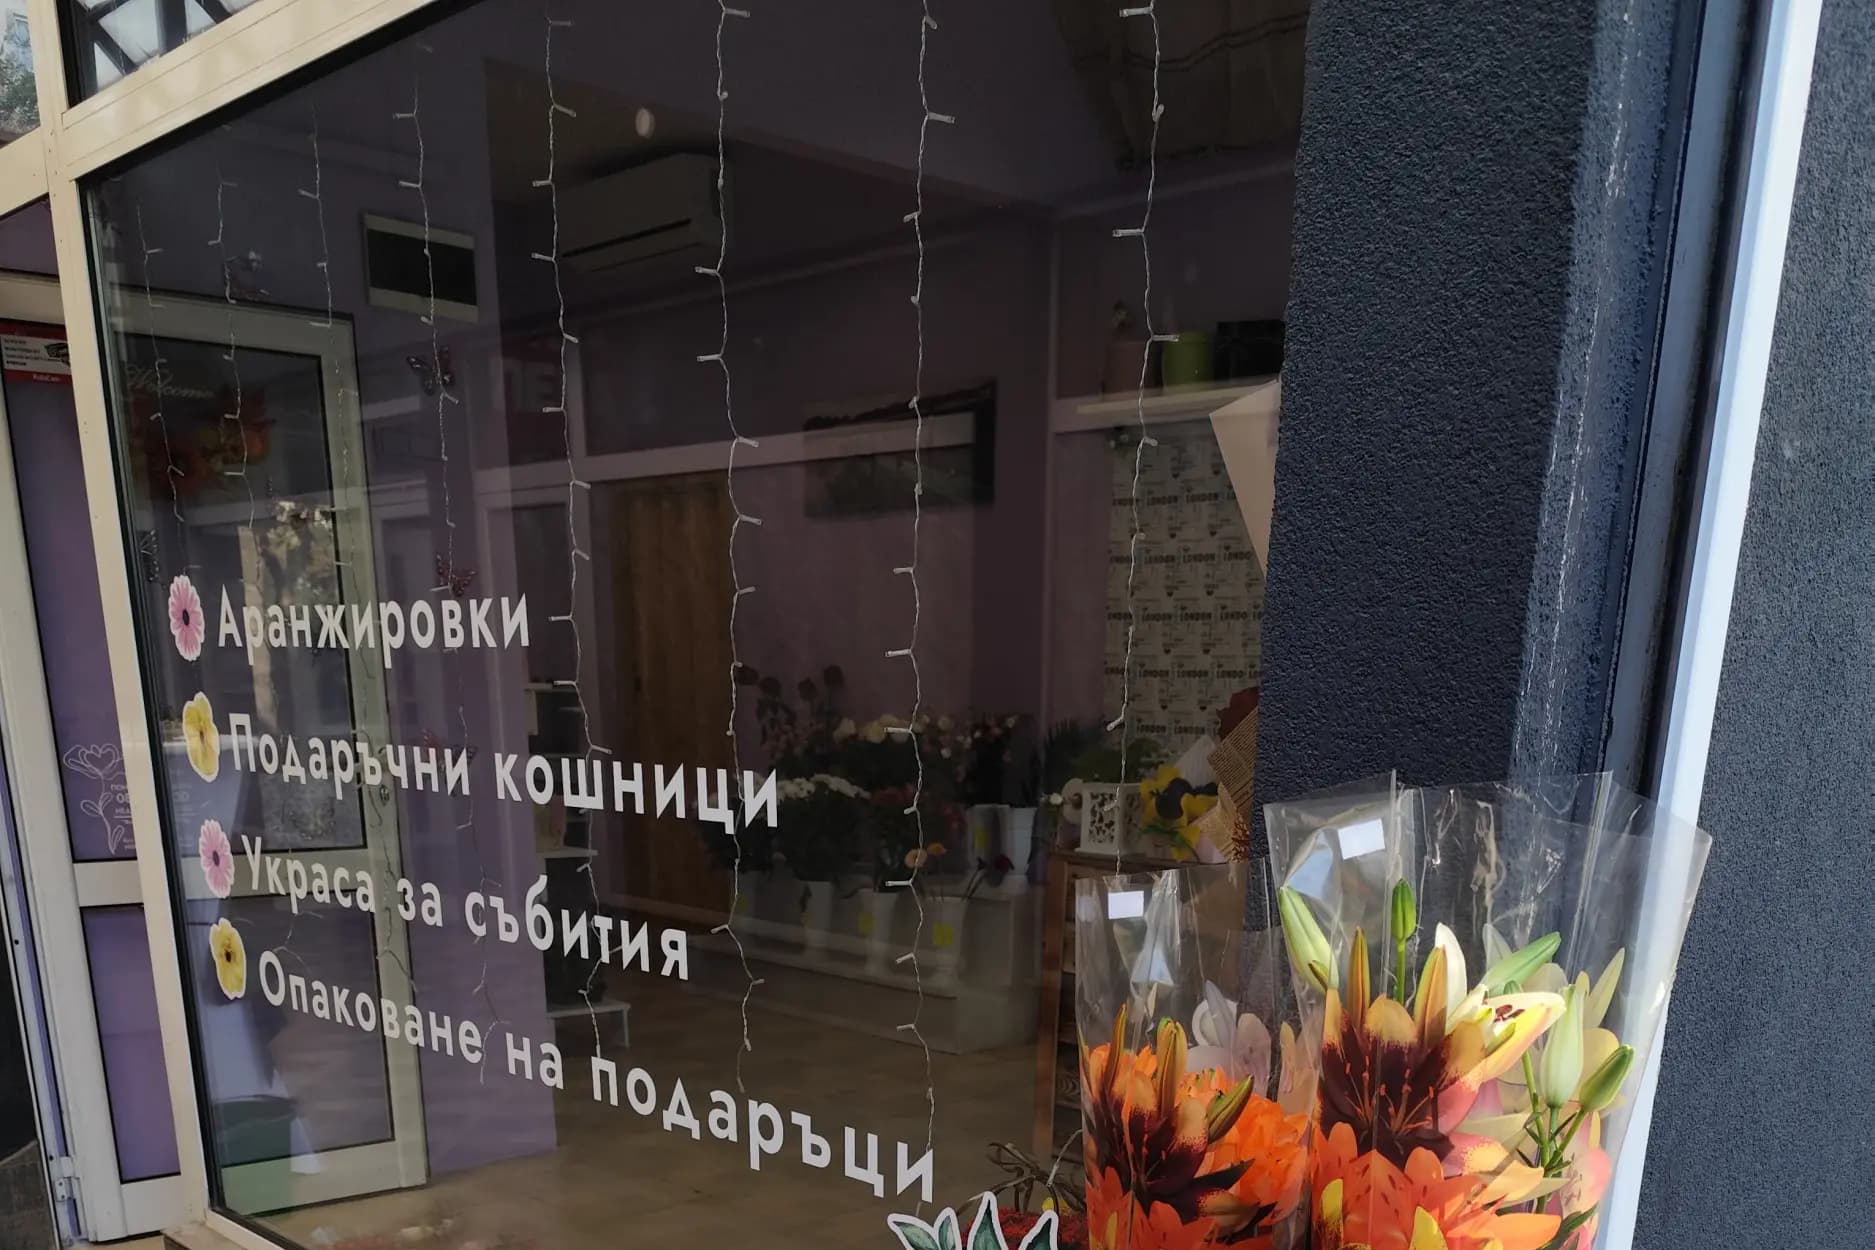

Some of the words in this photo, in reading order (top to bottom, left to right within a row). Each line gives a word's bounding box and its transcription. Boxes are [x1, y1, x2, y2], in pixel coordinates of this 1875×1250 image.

[217, 585, 530, 669] Аранжировки
[228, 712, 470, 799] Подаръчни
[495, 752, 779, 834] кошници
[240, 834, 375, 915] Украса
[396, 876, 443, 928] за
[465, 874, 690, 980] събития
[258, 951, 483, 1063] Опаковане
[506, 1032, 564, 1090] на
[590, 1053, 934, 1203] подаръци
